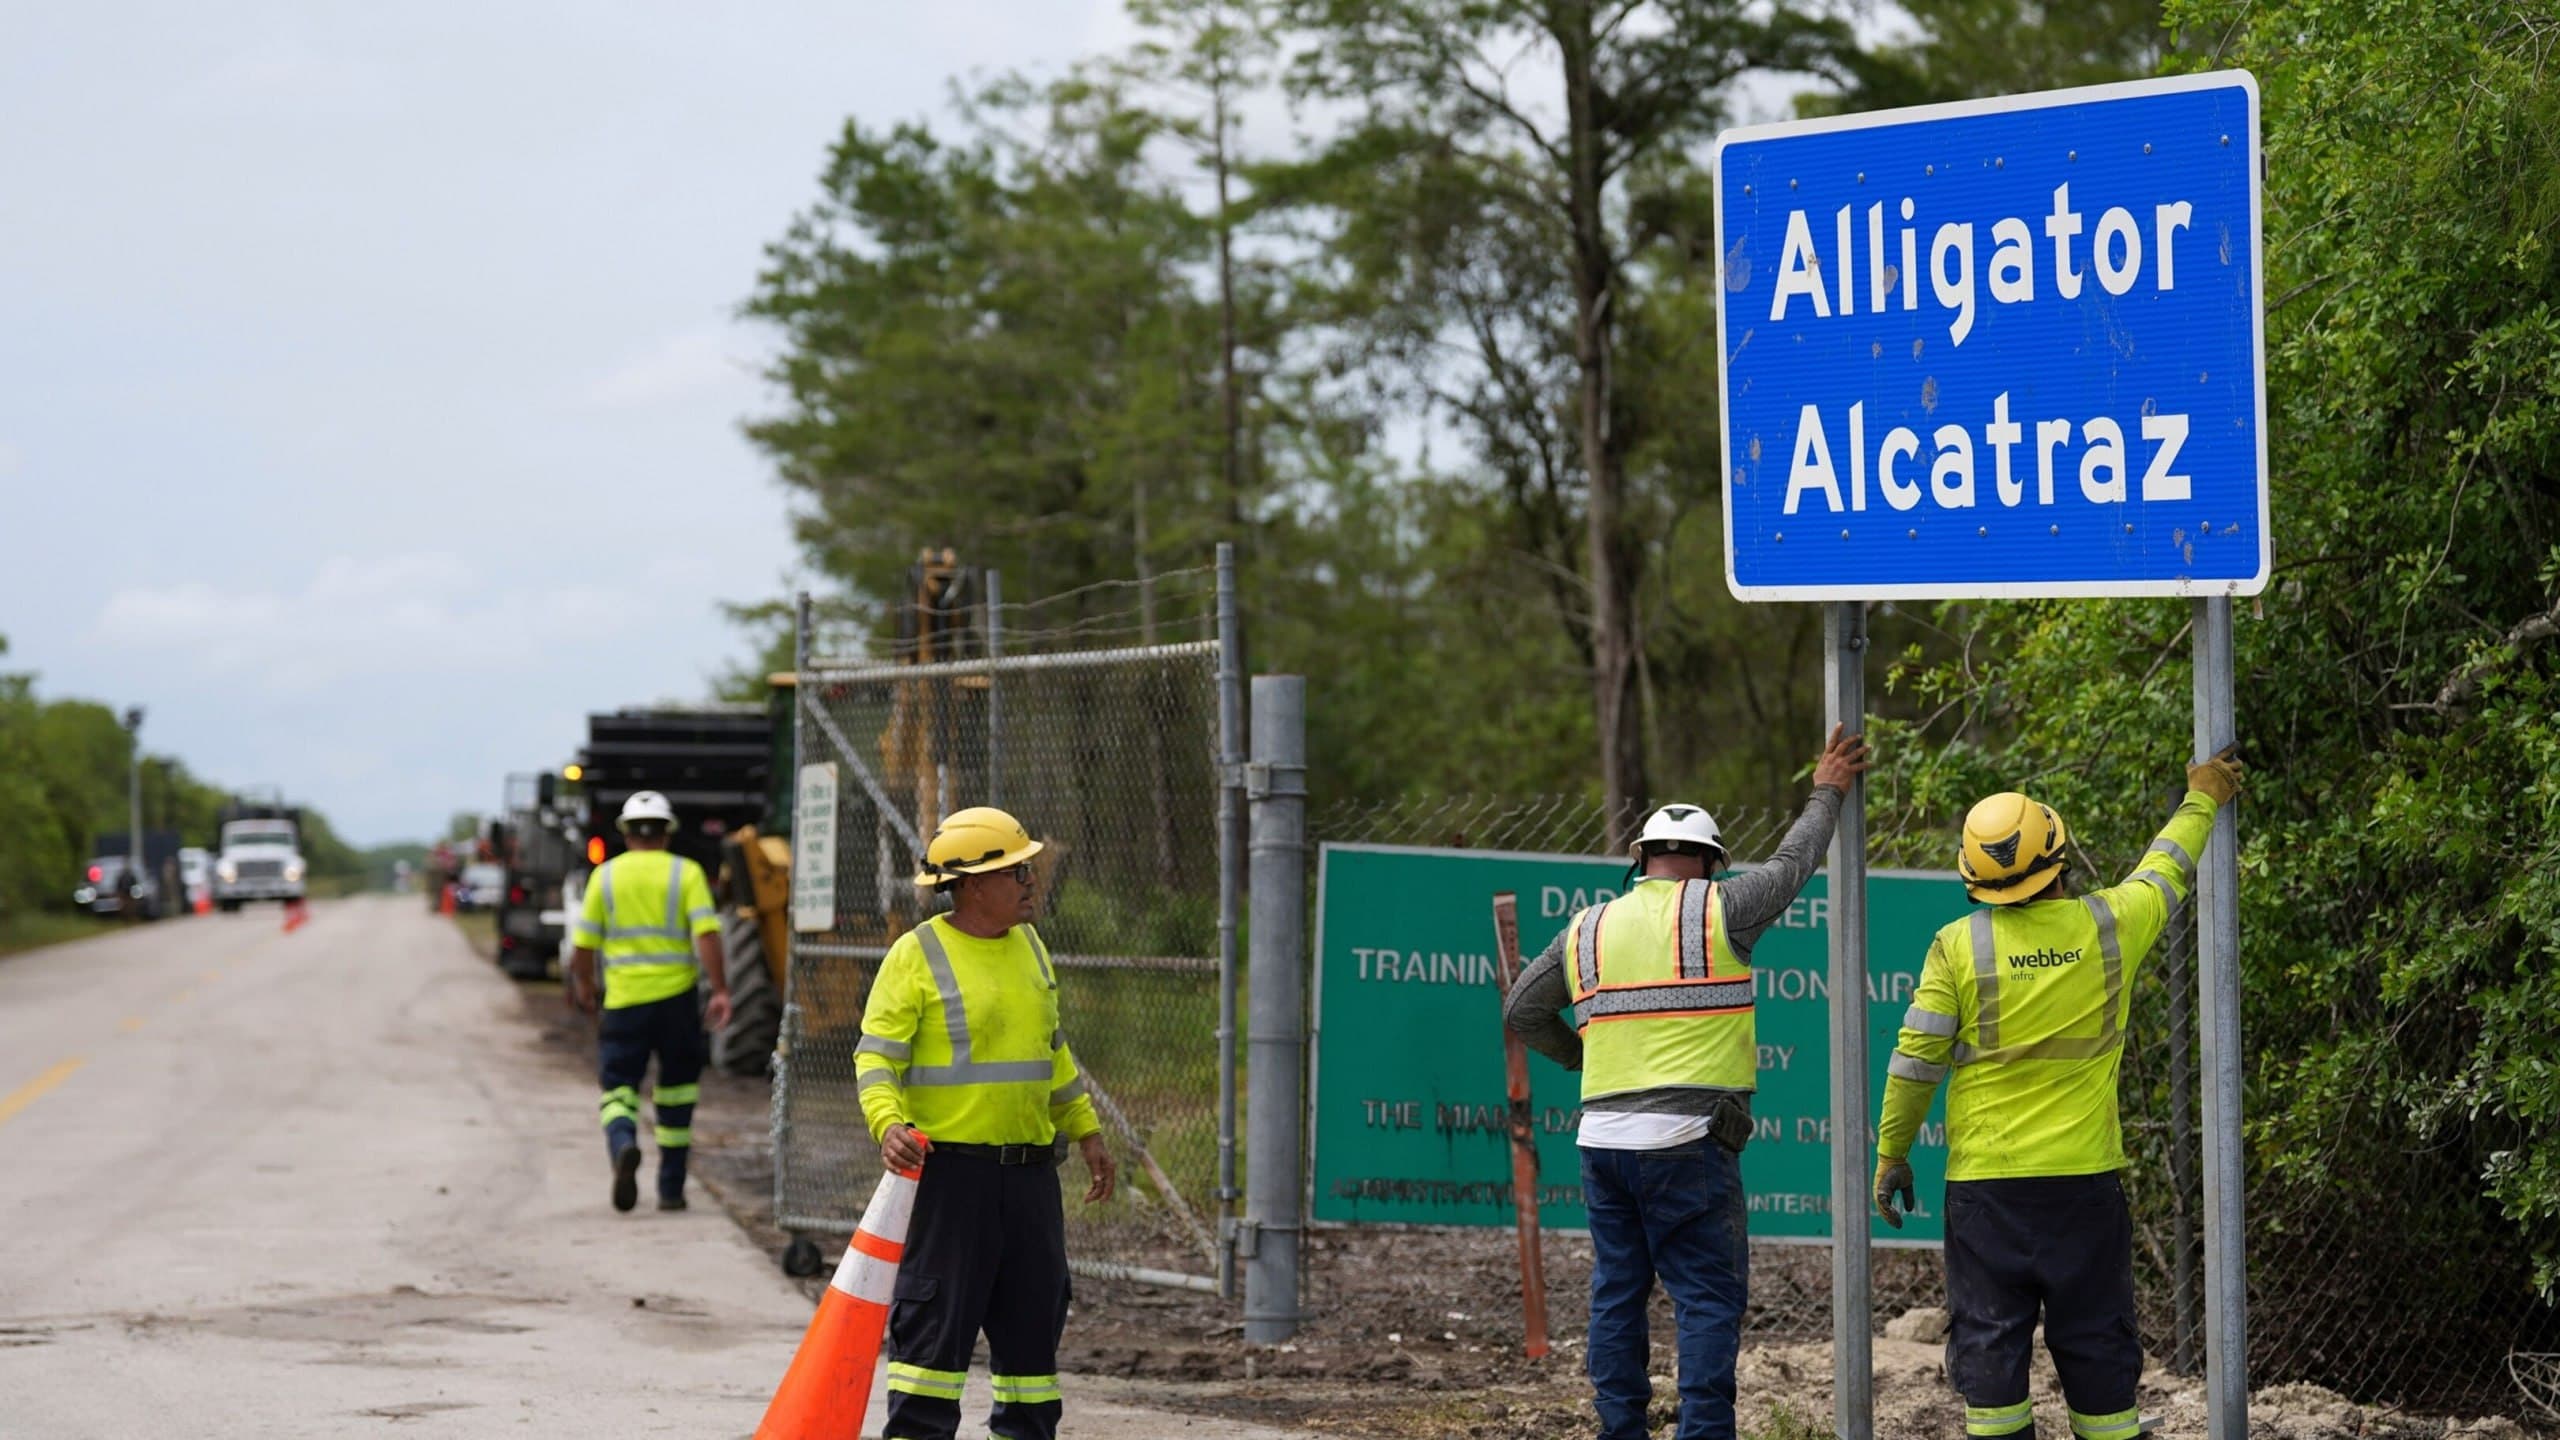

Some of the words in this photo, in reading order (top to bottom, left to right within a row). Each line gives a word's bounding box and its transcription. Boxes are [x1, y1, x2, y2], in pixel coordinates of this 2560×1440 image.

[1770, 181, 2193, 347] Alligator
[1783, 391, 2192, 515] Alcatraz
[1352, 948, 1531, 986] TRAININ
[2008, 947, 2082, 968] webber
[2010, 971, 2034, 981] infra
[1757, 1044, 1795, 1071] BY
[1363, 1100, 1422, 1130] THE
